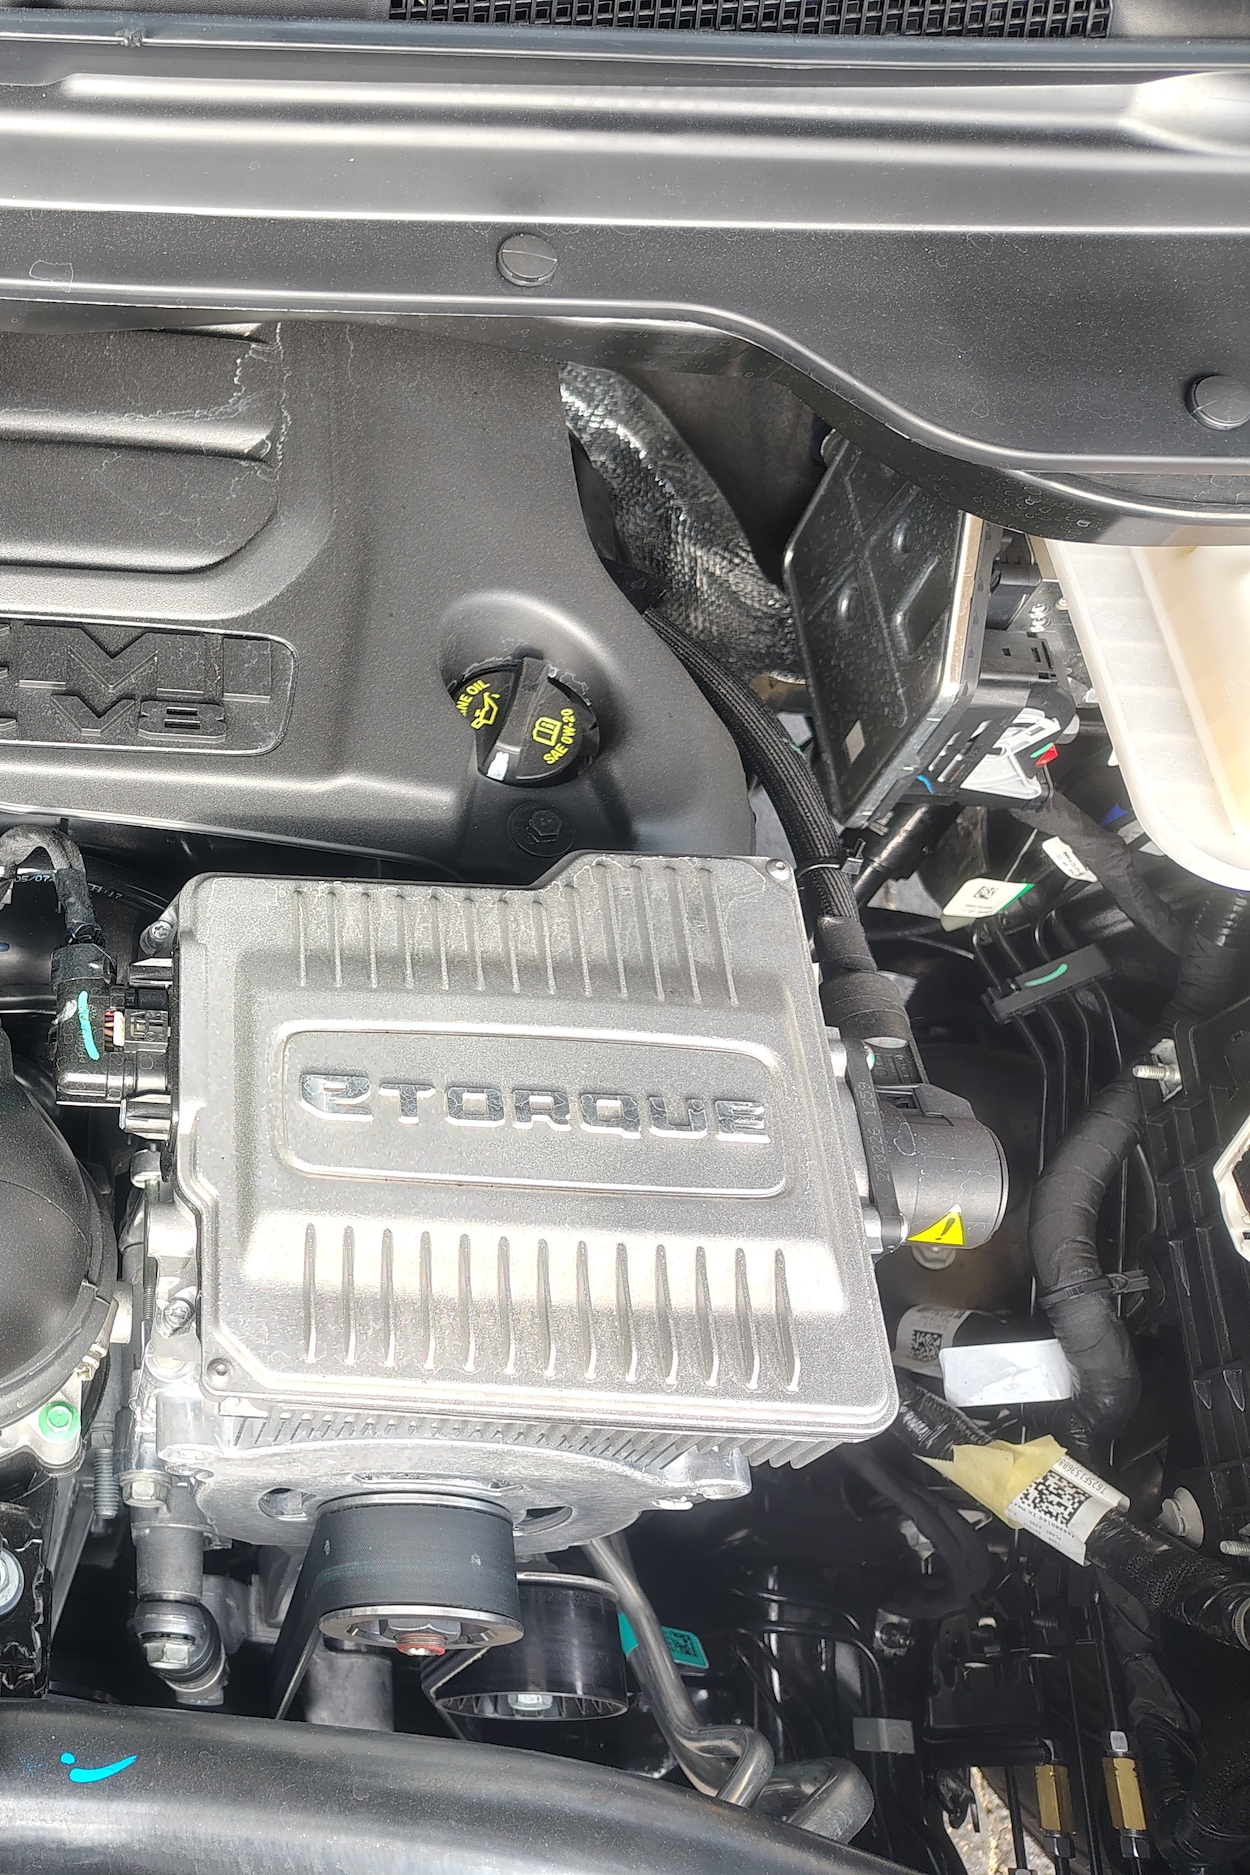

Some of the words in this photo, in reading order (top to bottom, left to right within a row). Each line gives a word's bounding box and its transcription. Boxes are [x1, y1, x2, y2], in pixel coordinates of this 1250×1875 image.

[465, 679, 490, 696] OIL
[51, 693, 227, 743] V8
[543, 743, 569, 765] SAE
